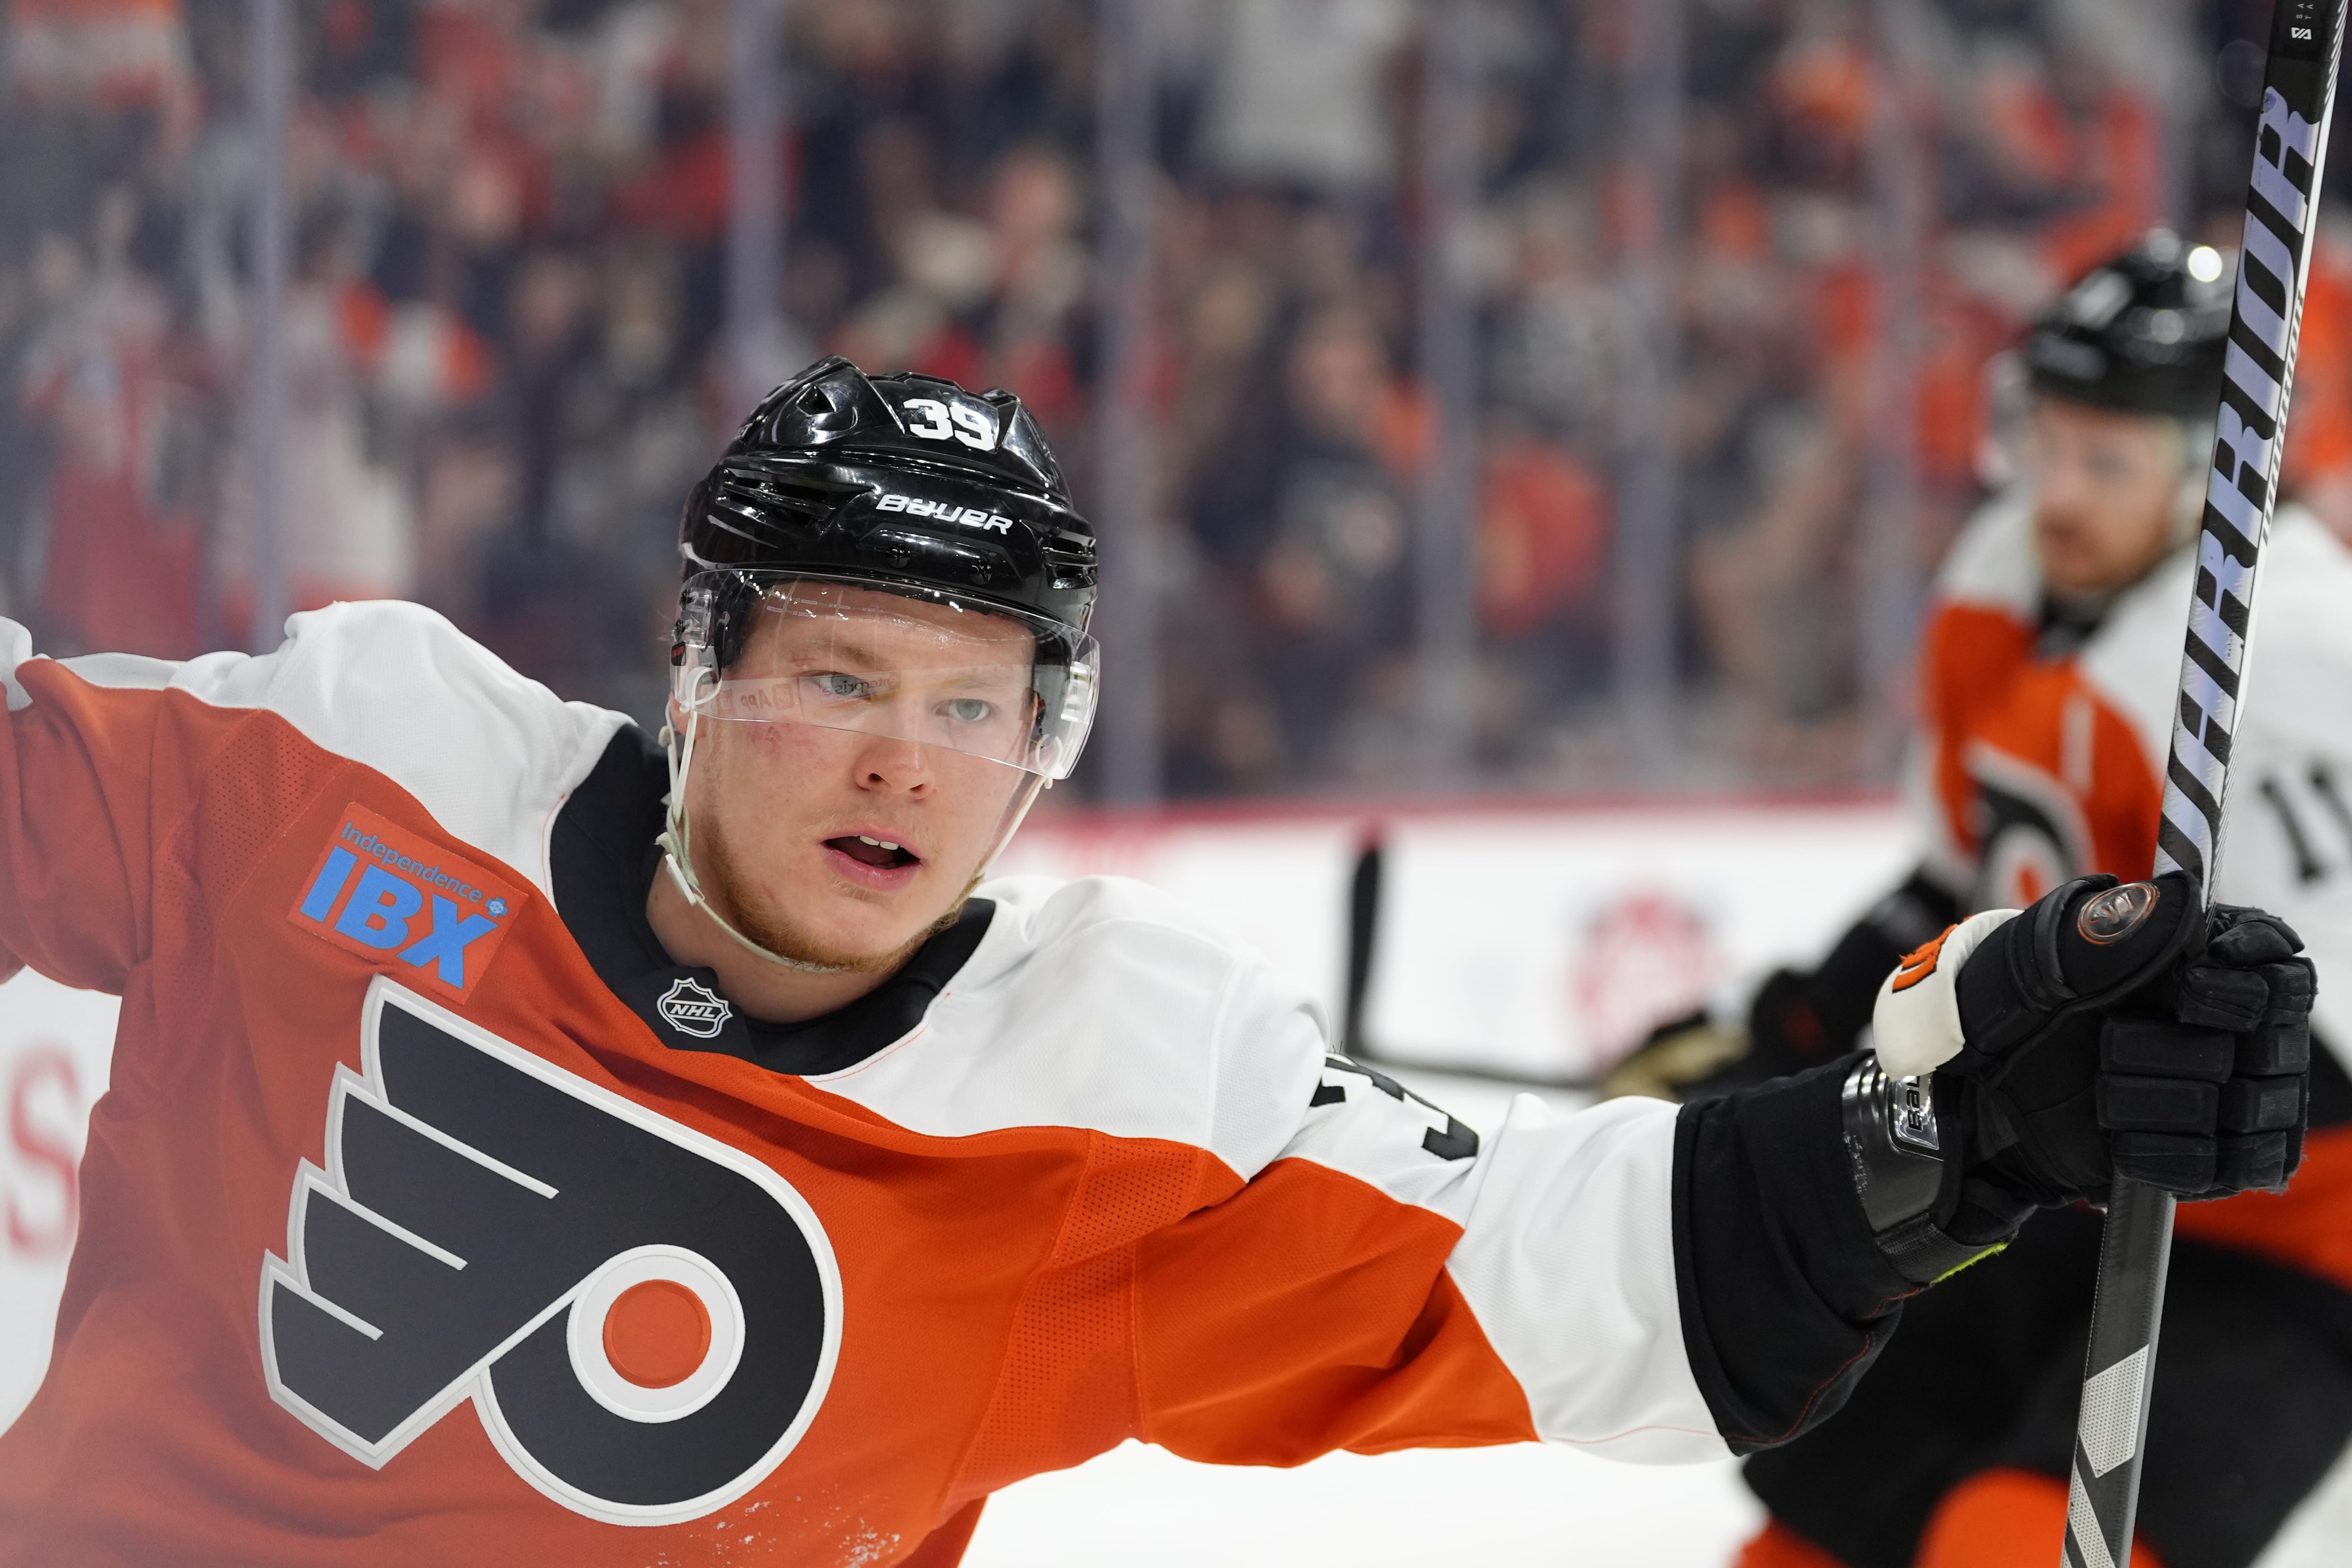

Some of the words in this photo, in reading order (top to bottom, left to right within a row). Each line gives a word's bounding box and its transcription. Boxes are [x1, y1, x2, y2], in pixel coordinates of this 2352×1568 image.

[903, 399, 999, 451] 39
[341, 821, 483, 903] Independence
[299, 846, 499, 990] IBX
[670, 1004, 715, 1018] NHL
